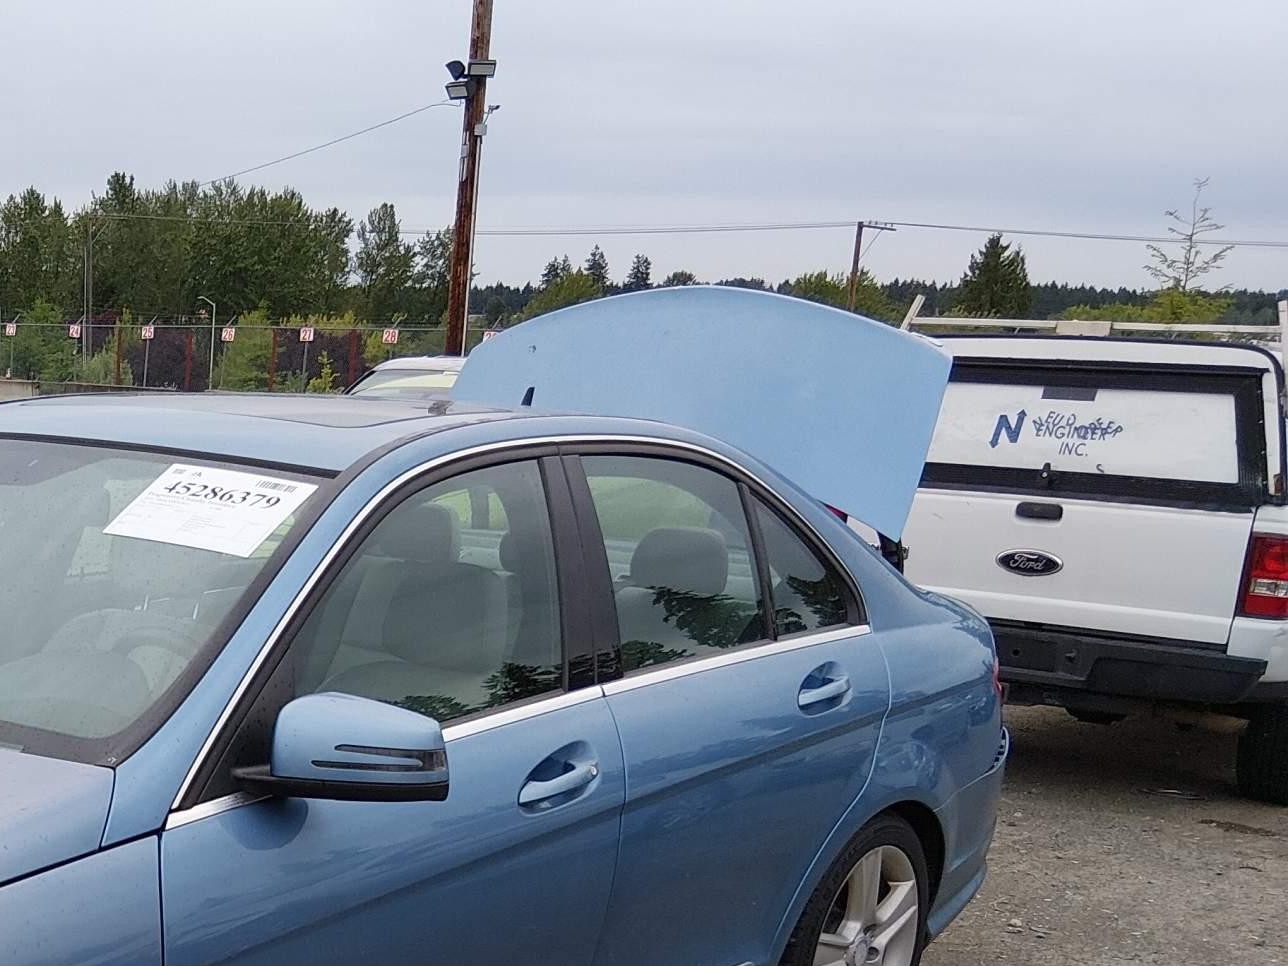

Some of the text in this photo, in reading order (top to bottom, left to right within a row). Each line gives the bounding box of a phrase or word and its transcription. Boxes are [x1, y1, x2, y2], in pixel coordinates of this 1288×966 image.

[7, 325, 16, 335] 23
[71, 326, 80, 337] 24
[143, 327, 153, 338] 25
[223, 329, 234, 340] 26
[301, 329, 312, 341] 27
[384, 330, 397, 342] 28
[1058, 441, 1089, 457] INC.
[163, 481, 281, 509] 45286379
[1009, 553, 1046, 571] Ford
